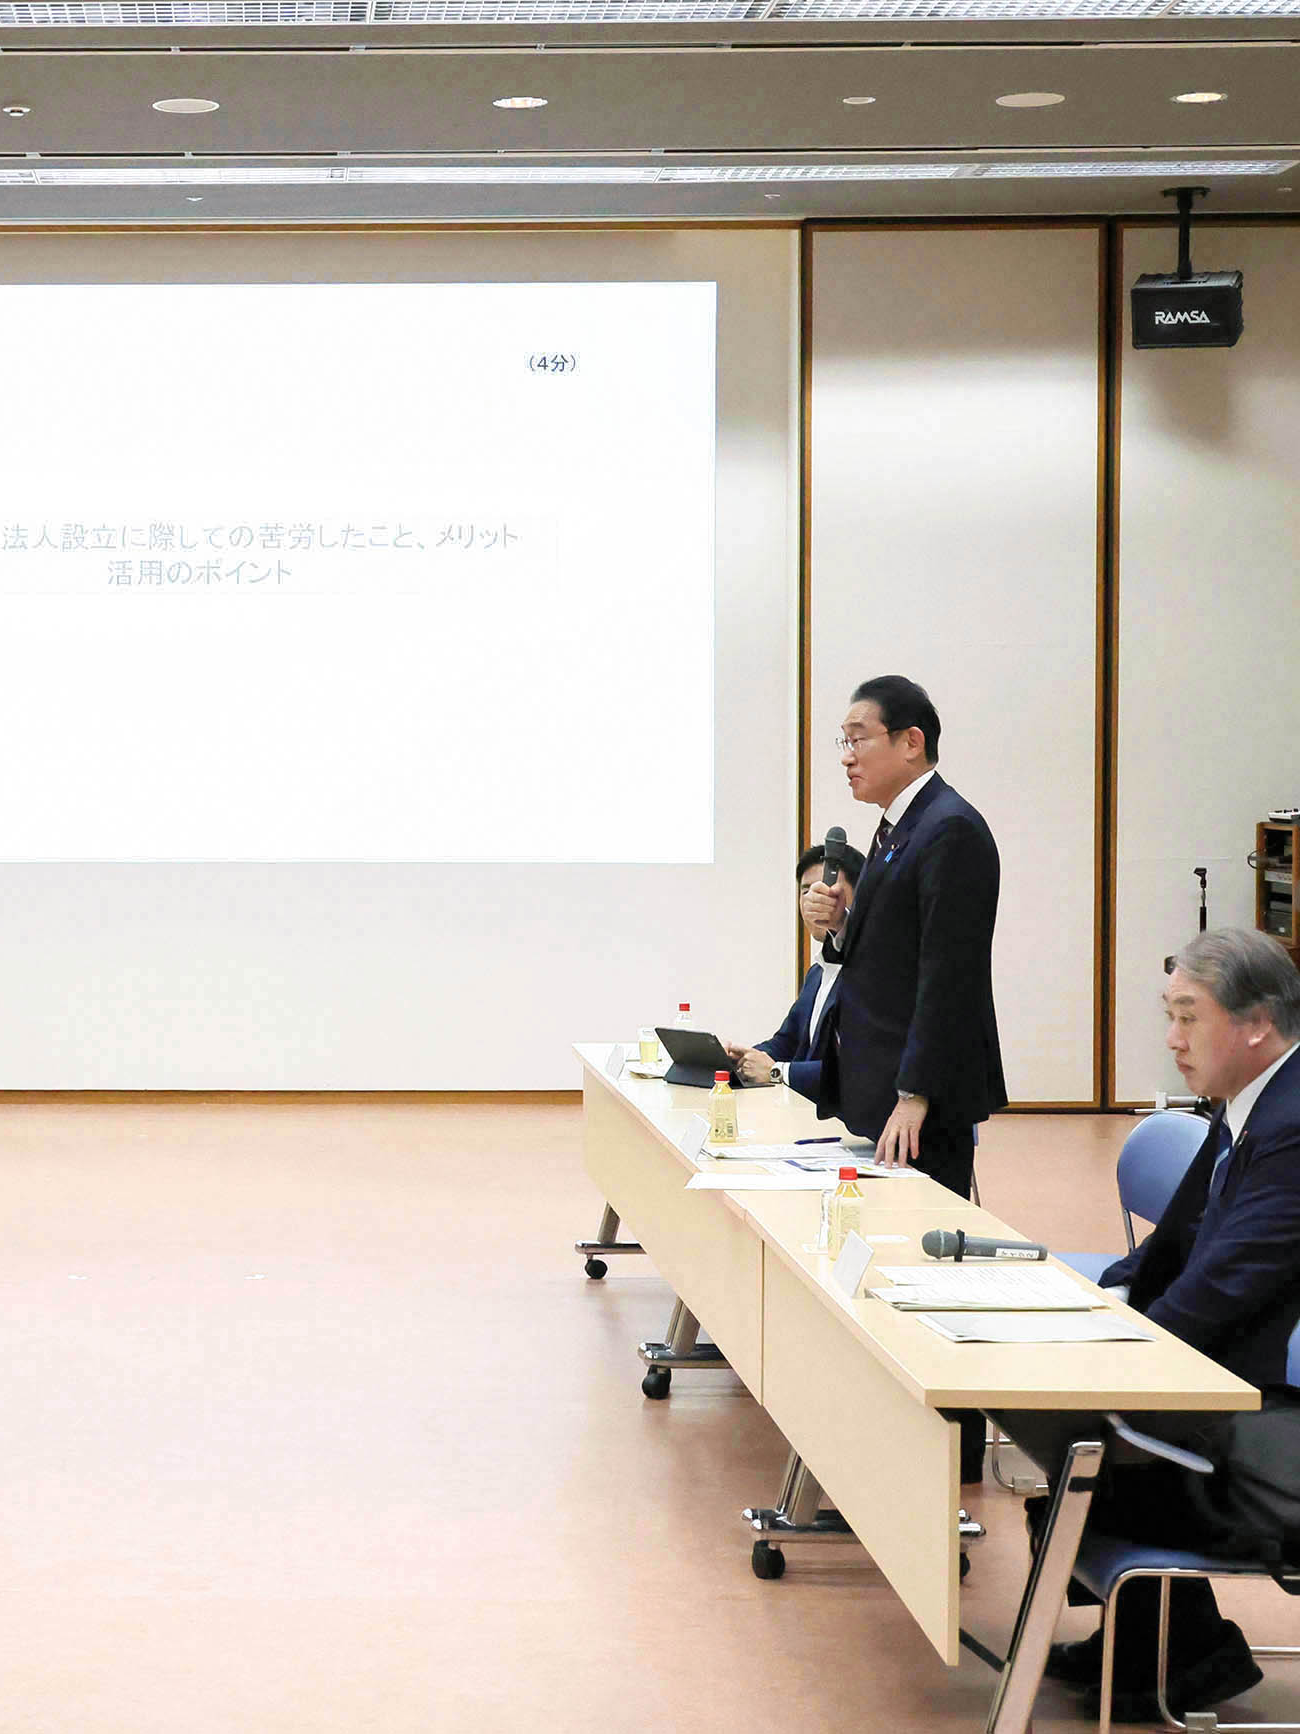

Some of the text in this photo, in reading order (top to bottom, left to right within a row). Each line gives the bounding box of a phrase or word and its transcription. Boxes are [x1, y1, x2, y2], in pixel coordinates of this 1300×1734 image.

[1155, 311, 1210, 325] RAMSA
[108, 559, 292, 585] 活用のポイント
